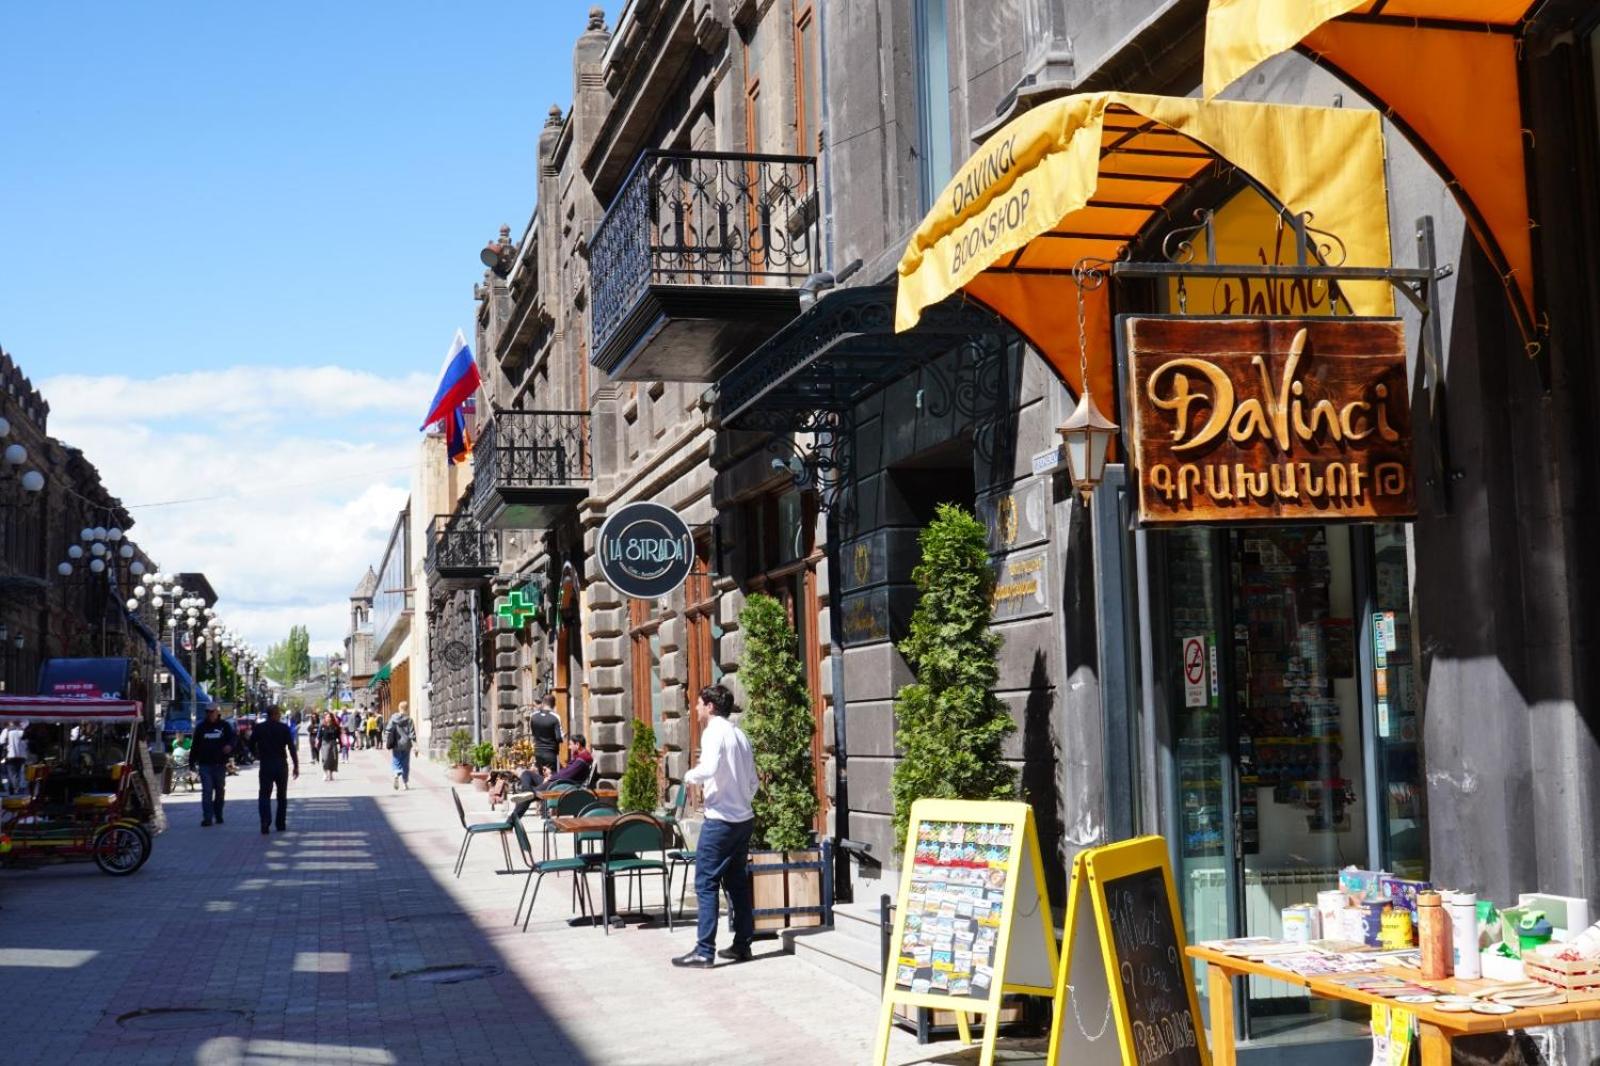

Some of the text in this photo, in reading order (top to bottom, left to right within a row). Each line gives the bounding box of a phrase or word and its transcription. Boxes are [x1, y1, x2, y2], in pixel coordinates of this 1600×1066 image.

[952, 134, 1017, 216] DAVINCI
[951, 188, 1030, 275] BOOKSHOP
[1149, 328, 1398, 451] DaVinci
[610, 538, 622, 560] LA
[1133, 1010, 1196, 1066] READING
